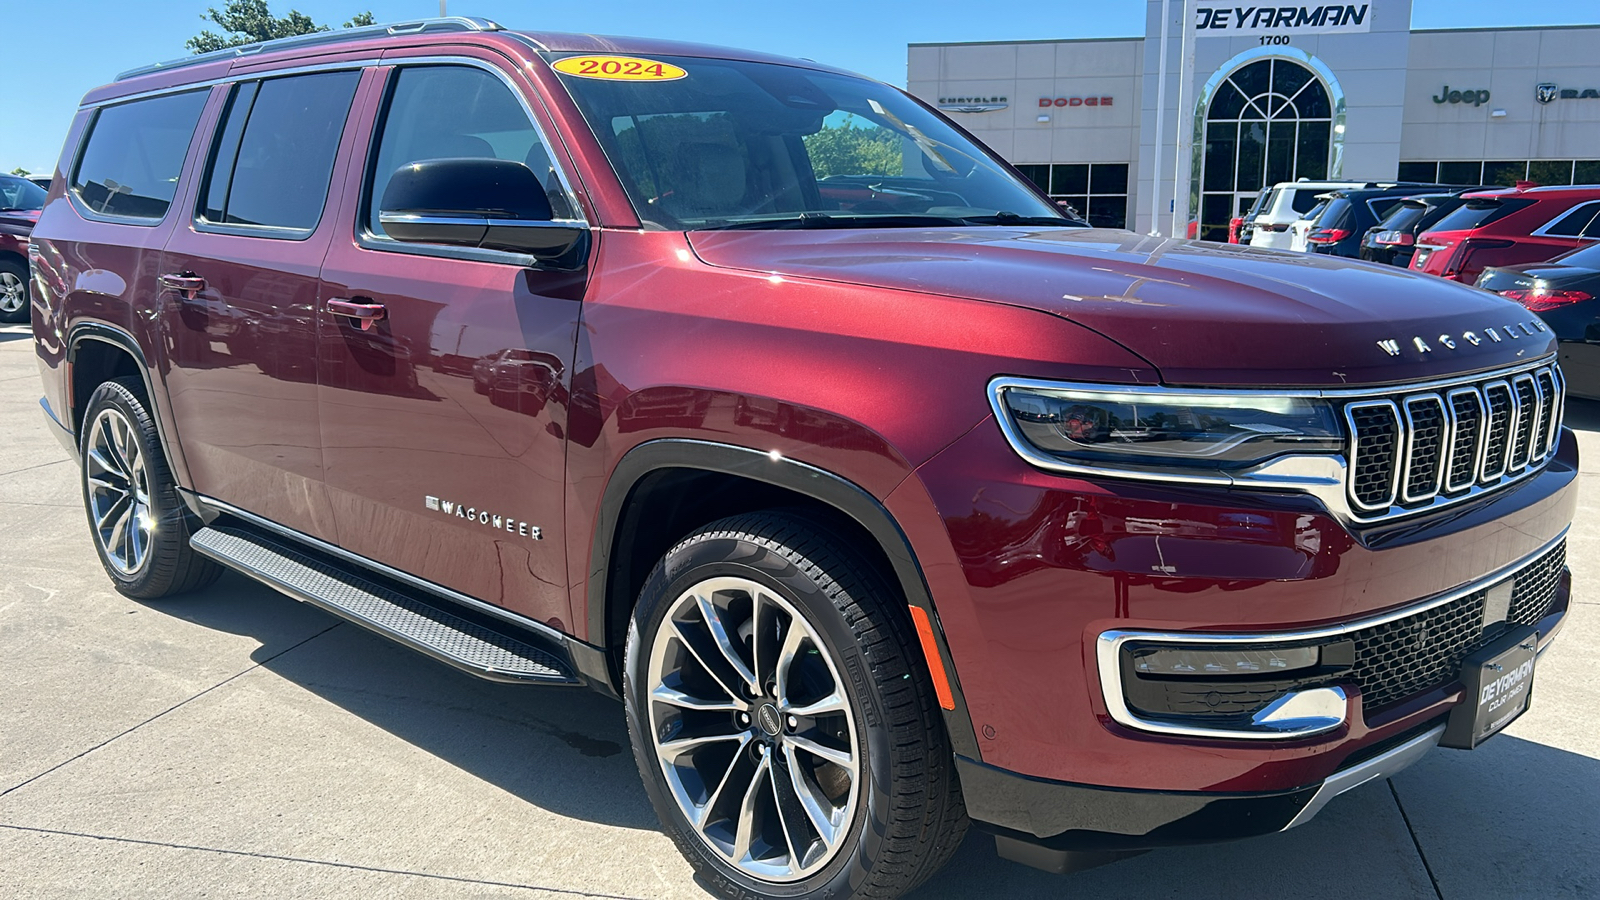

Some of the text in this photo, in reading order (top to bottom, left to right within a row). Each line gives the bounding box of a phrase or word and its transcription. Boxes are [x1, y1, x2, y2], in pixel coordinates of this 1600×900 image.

[1196, 4, 1369, 30] DEYARMAN
[1259, 35, 1290, 46] 1700
[579, 60, 666, 77] 2024
[1039, 97, 1113, 107] DODGE
[1433, 86, 1490, 107] Jeep
[1561, 89, 1600, 99] RA
[441, 500, 544, 540] WAGONEER
[1480, 656, 1535, 706] DEYARMAN
